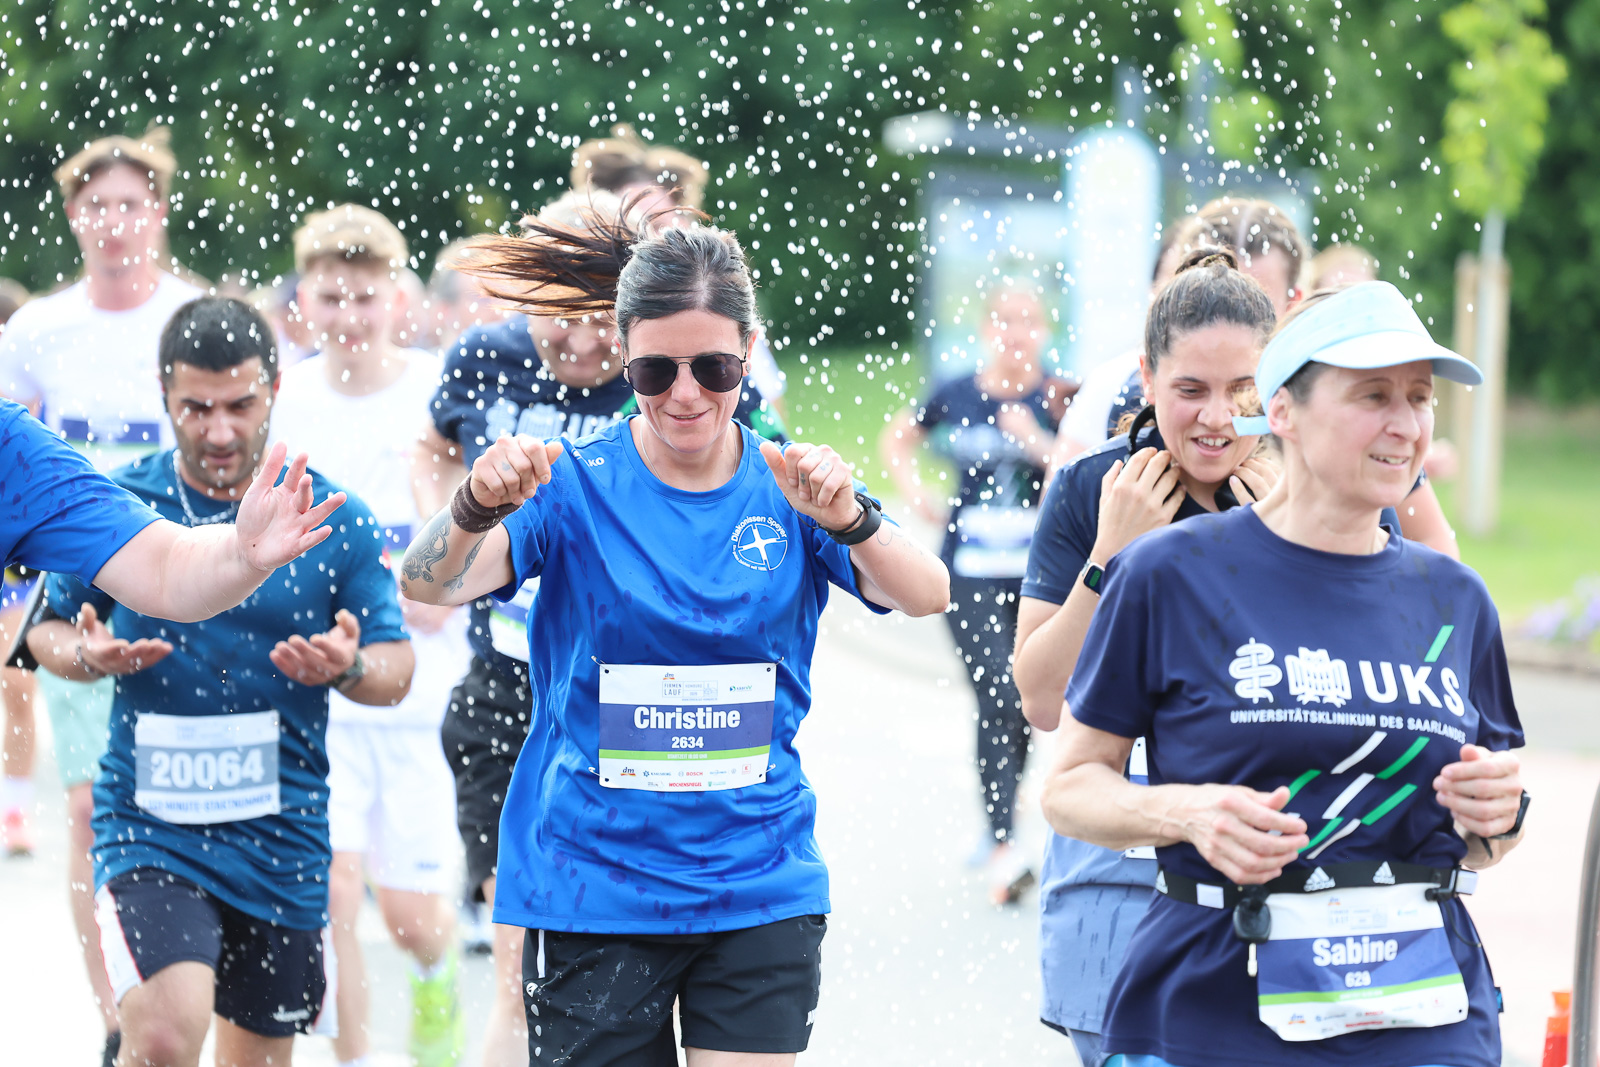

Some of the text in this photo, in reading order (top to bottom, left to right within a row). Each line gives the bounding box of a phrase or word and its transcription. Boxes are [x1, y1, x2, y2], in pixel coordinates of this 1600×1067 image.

[731, 516, 787, 542] Diakonissen Speyer
[1358, 660, 1465, 717] UKS
[634, 706, 741, 730] Christine
[1230, 707, 1467, 745] UNIVERSITÄTSKLINIKUM DES SAARLANDES
[671, 736, 704, 749] 2634
[150, 748, 265, 789] 20064
[622, 766, 635, 774] dm
[1312, 936, 1398, 967] Sabine
[1345, 970, 1371, 988] 629
